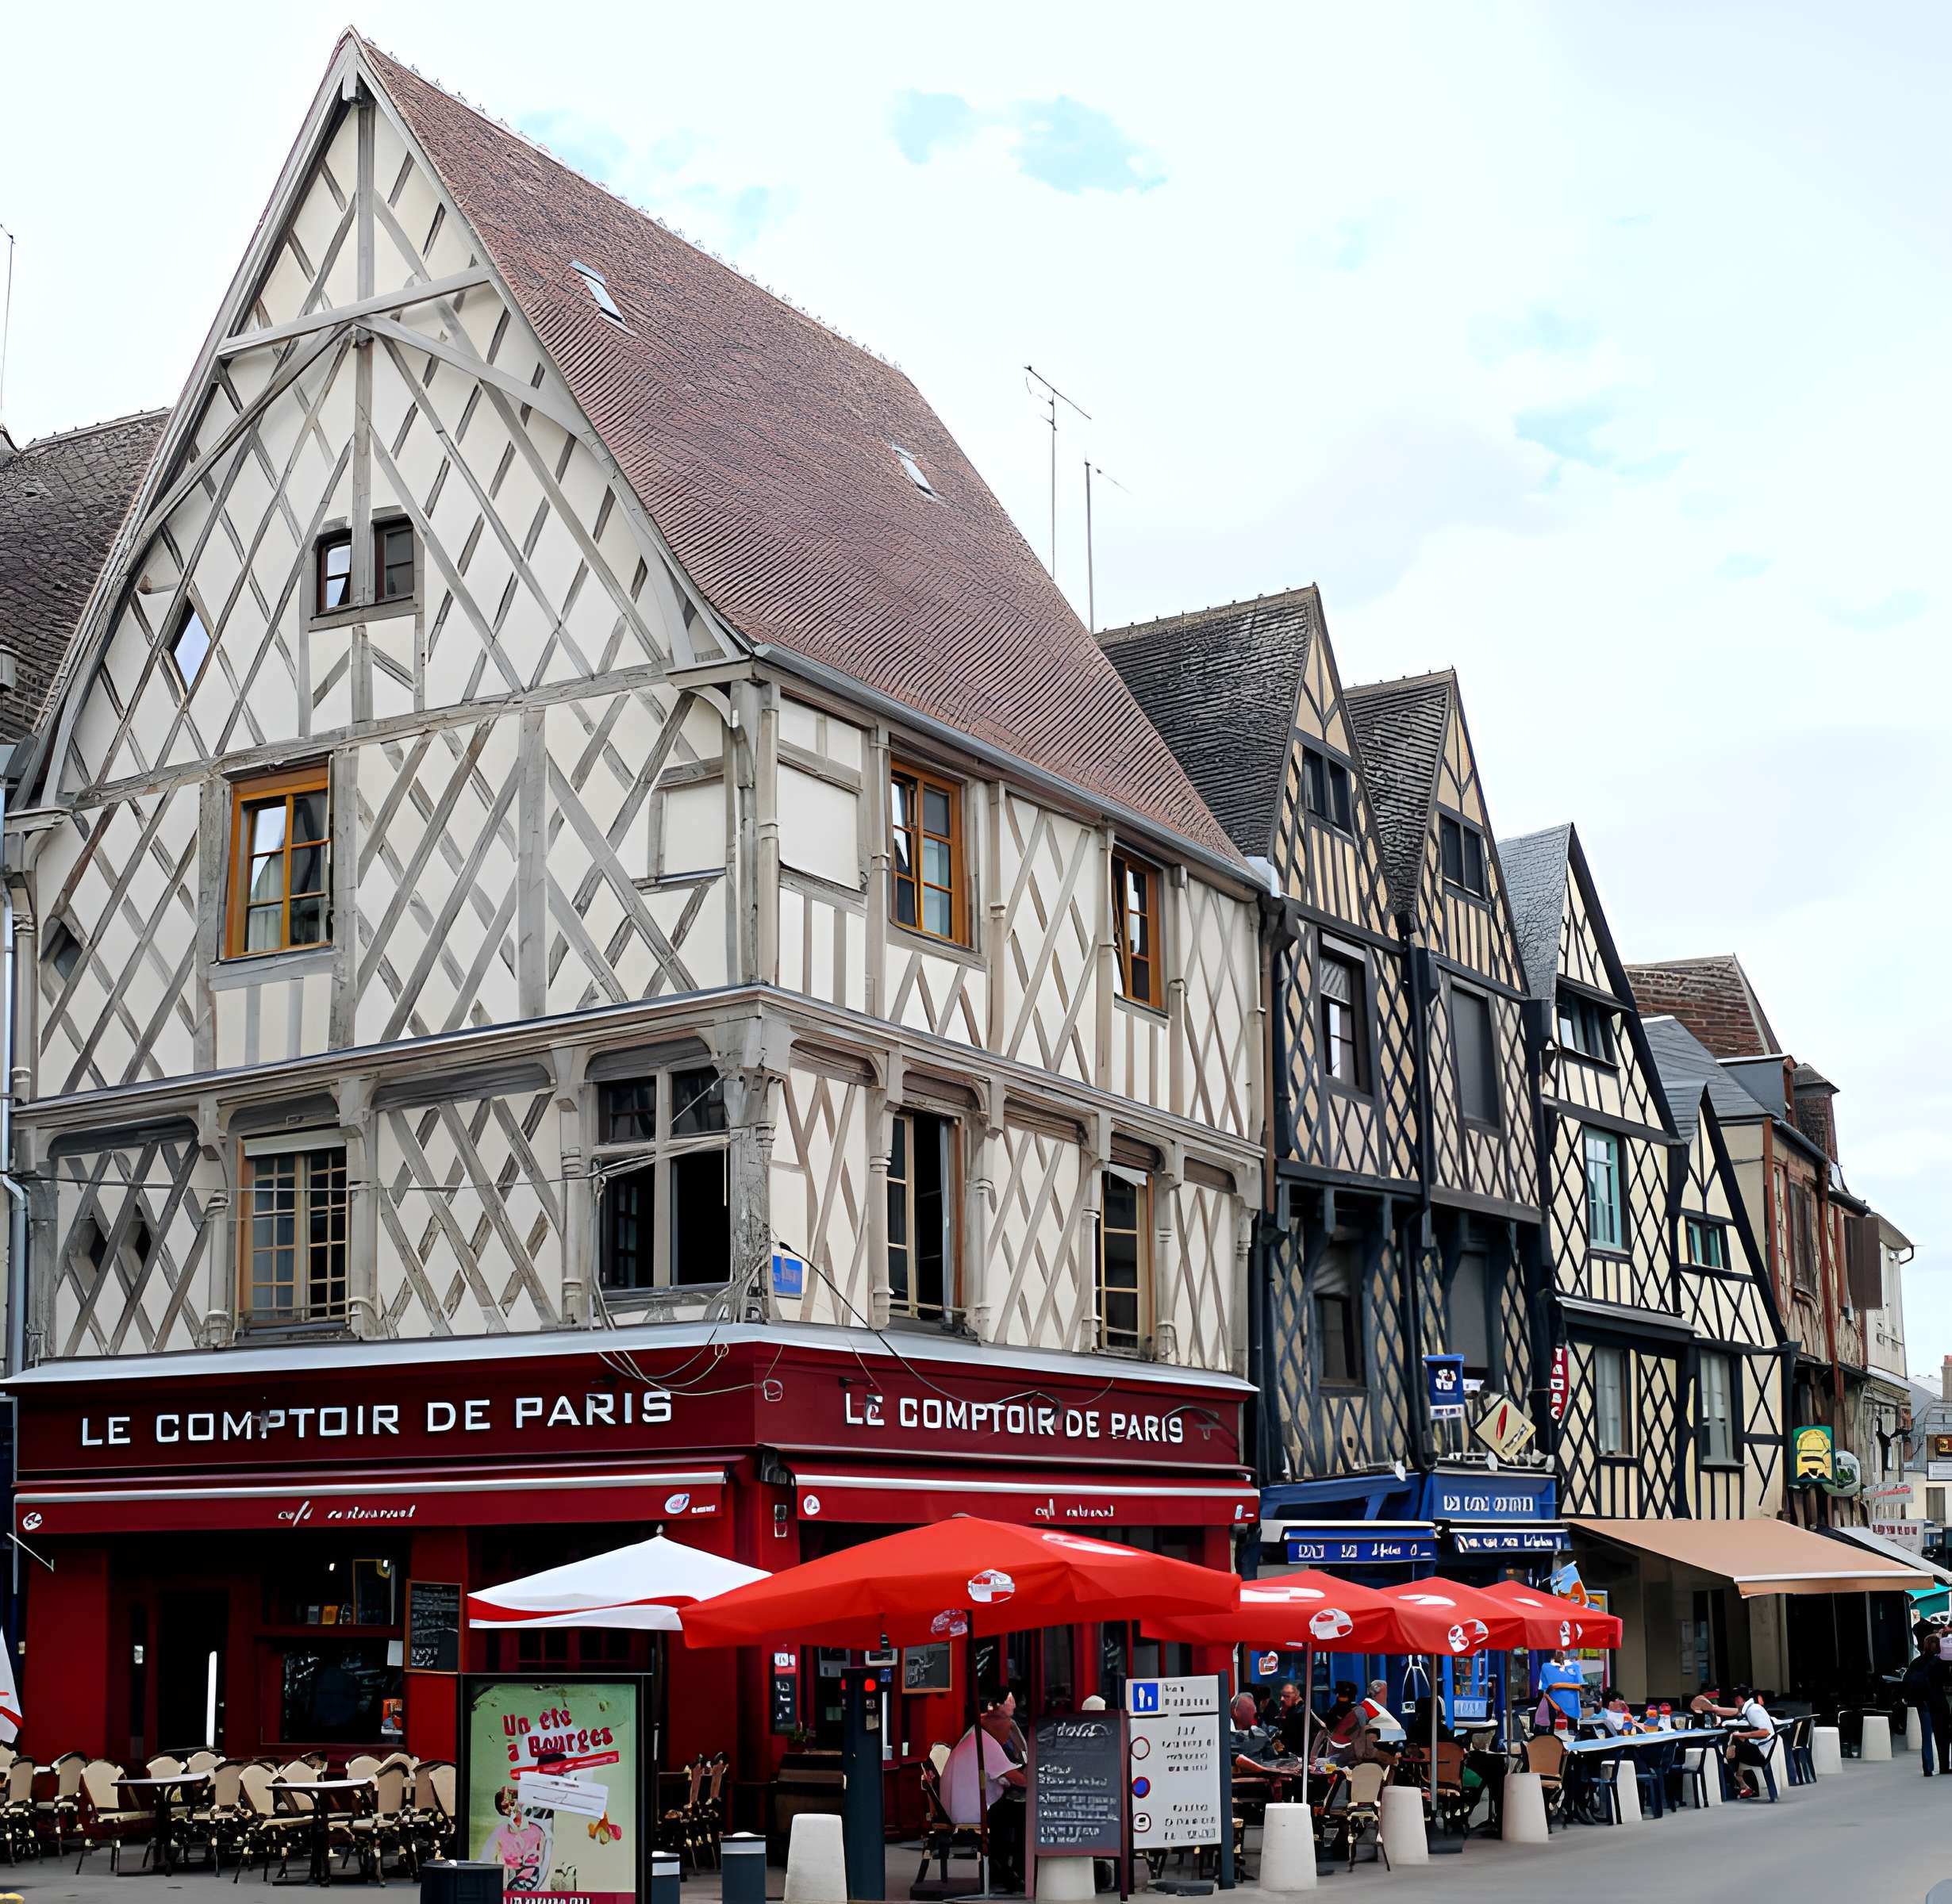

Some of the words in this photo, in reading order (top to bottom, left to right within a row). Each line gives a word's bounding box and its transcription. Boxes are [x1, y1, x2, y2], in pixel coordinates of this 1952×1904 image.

[82, 1417, 130, 1445] LE
[156, 1405, 399, 1442] COMPTOIR
[427, 1399, 490, 1431] DE
[516, 1391, 671, 1428] PARIS
[845, 1393, 885, 1426] LE
[899, 1398, 1055, 1436] COMPTOIR
[1066, 1409, 1100, 1438] DE
[1109, 1413, 1183, 1443] PARIS
